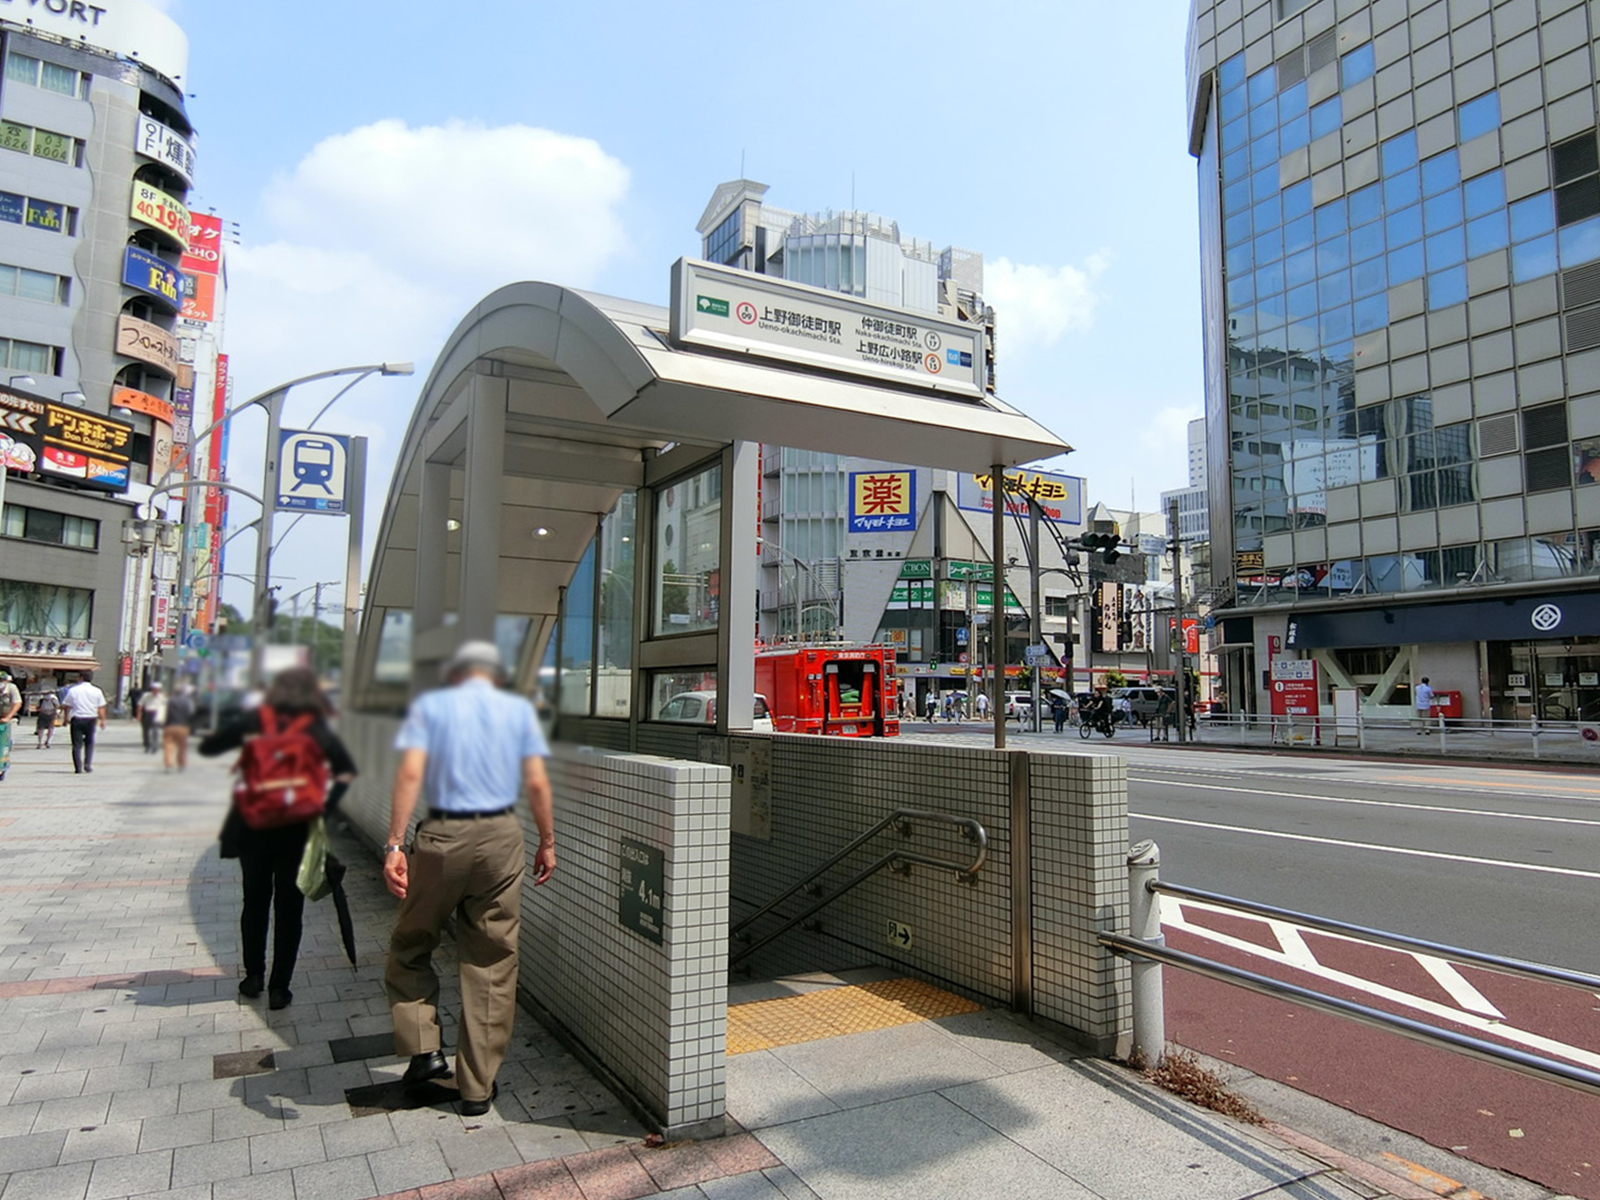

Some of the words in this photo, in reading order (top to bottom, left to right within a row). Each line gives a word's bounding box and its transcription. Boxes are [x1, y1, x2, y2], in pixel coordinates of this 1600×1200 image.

[140, 188, 157, 202] 8F
[26, 206, 60, 229] Fun
[149, 267, 177, 301] Fun
[741, 312, 753, 320] 09
[759, 305, 842, 336] 上野御徒町駅
[758, 321, 828, 342] Ueno-okachimachi
[829, 335, 843, 345] Sta.
[854, 328, 911, 346] Naka-okachimachi
[861, 316, 918, 340] 仲御徒町駅
[856, 340, 923, 365] 上野広小路駅
[929, 340, 938, 348] 17
[929, 363, 938, 371] 15
[63, 432, 81, 442] Don
[89, 463, 109, 477] 24h
[863, 474, 902, 514] 薬
[973, 474, 1066, 499] マモトキヨシ
[854, 516, 910, 530] マツモトキヨシ
[638, 880, 660, 910] 4.1m
